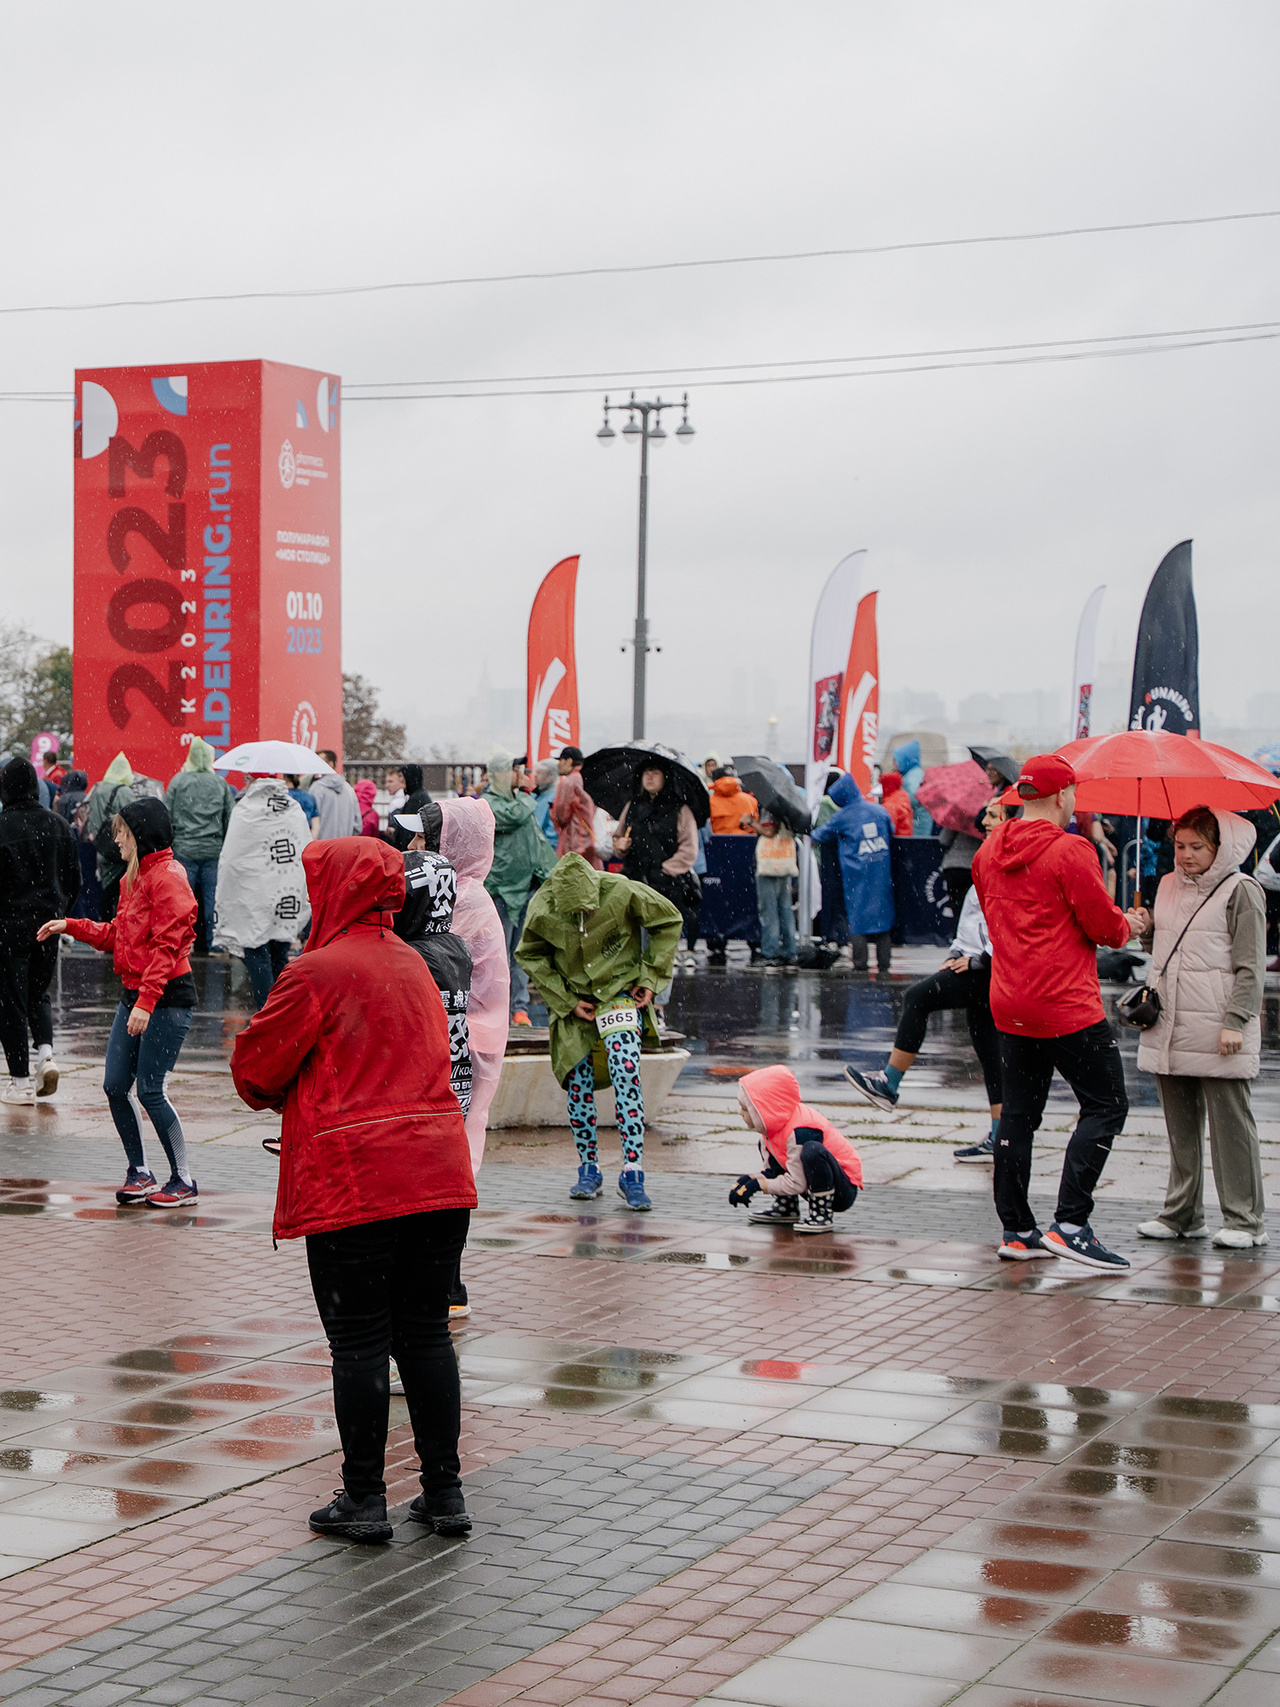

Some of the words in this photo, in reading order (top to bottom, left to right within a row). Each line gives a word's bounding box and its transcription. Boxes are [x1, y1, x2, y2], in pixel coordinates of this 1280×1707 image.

[107, 429, 188, 730] 2023
[203, 443, 232, 779] LDENRING.run
[286, 591, 322, 620] 01.10
[286, 626, 322, 654] 2023
[600, 1012, 633, 1028] 3665
